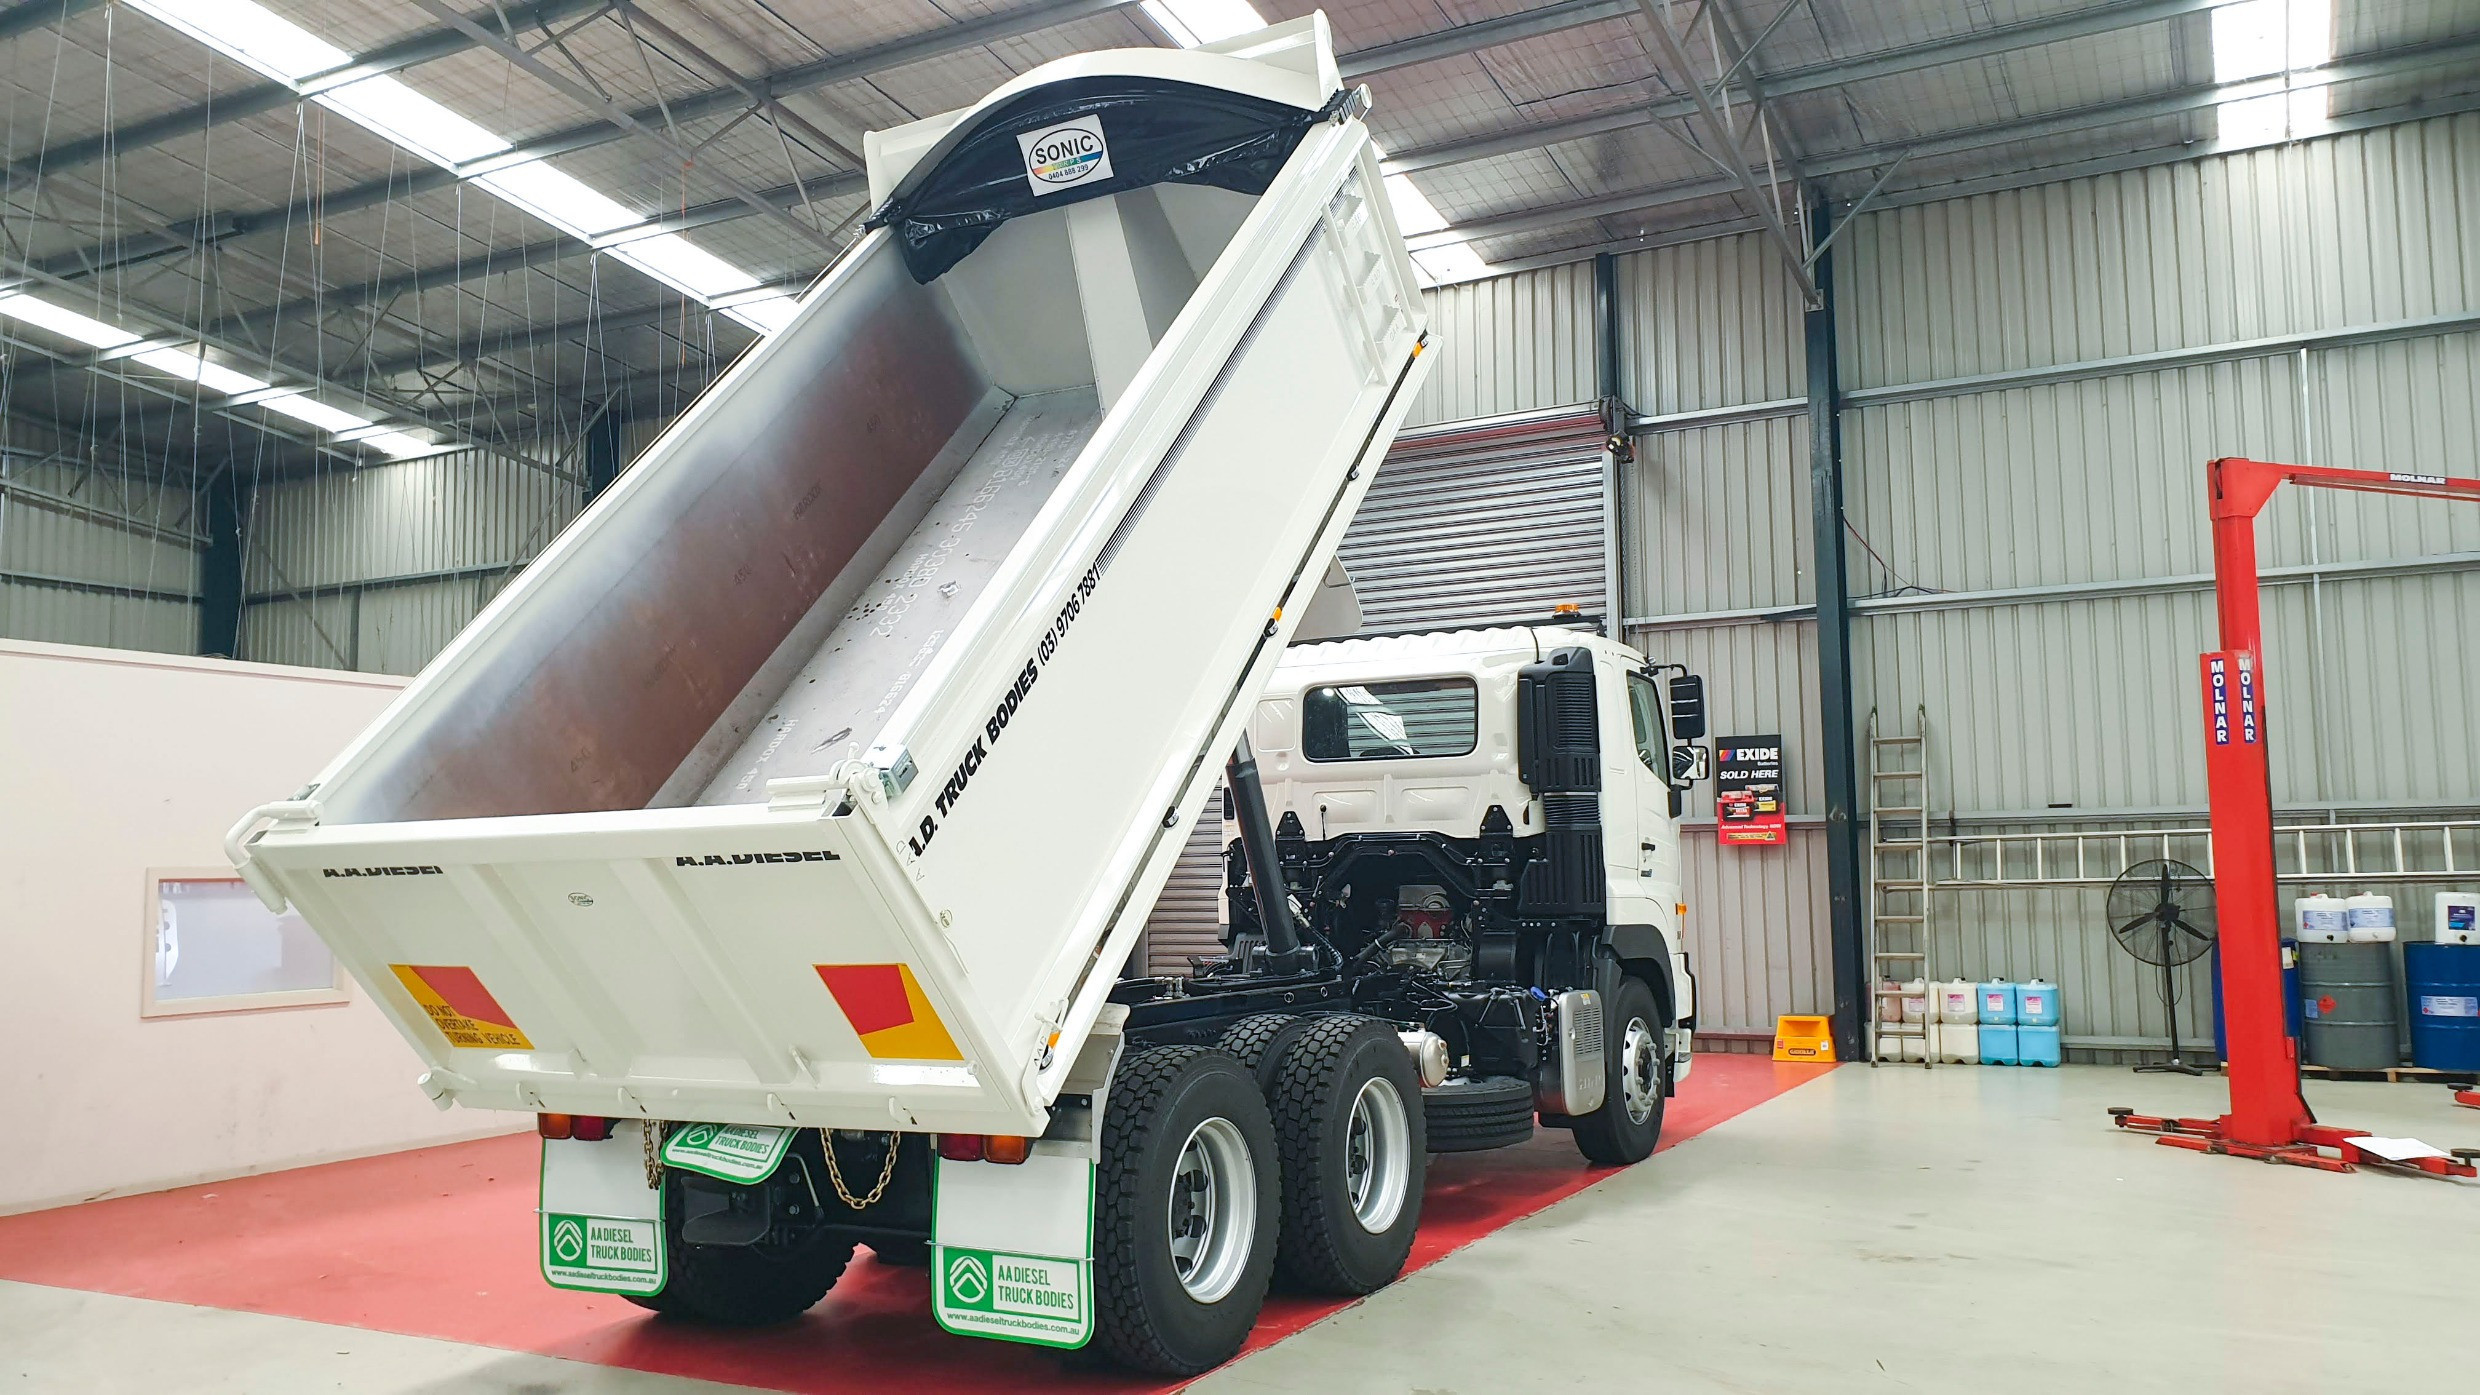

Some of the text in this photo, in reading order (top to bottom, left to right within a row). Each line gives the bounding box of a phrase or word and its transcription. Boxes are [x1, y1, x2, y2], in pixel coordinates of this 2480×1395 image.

[1035, 135, 1094, 165] SONIC
[1048, 172, 1064, 181] 0404
[2389, 473, 2446, 485] MOLNAR
[869, 593, 918, 637] 2332
[935, 734, 987, 819] TRUCK
[985, 657, 1038, 746] BODIES
[1037, 627, 1059, 667] (03)
[1056, 593, 1079, 638] 9706
[1077, 561, 1101, 606] 7881
[2210, 660, 2227, 742] MOLNAR
[2238, 658, 2255, 741] MOLNAR
[735, 719, 799, 790] HARDOX 450
[1736, 747, 1779, 761] EXIDE
[1720, 769, 1780, 780] SOLD HERE
[423, 1003, 455, 1017] DO NOT
[435, 1018, 479, 1031] OVERTAKE
[445, 1031, 521, 1046] TURNING VEHICLE
[714, 1135, 770, 1154] TRUCK BODIES
[603, 1228, 634, 1243] DIESEL
[590, 1244, 652, 1262] TRUCK BODIES
[551, 1268, 657, 1285] www.aadieseltruckbodies.com.au
[1013, 1266, 1051, 1286] DIESEL
[998, 1285, 1074, 1310] TRUCK BODIES
[946, 1312, 1080, 1336] www.aadieseltruckbodies.com.au
